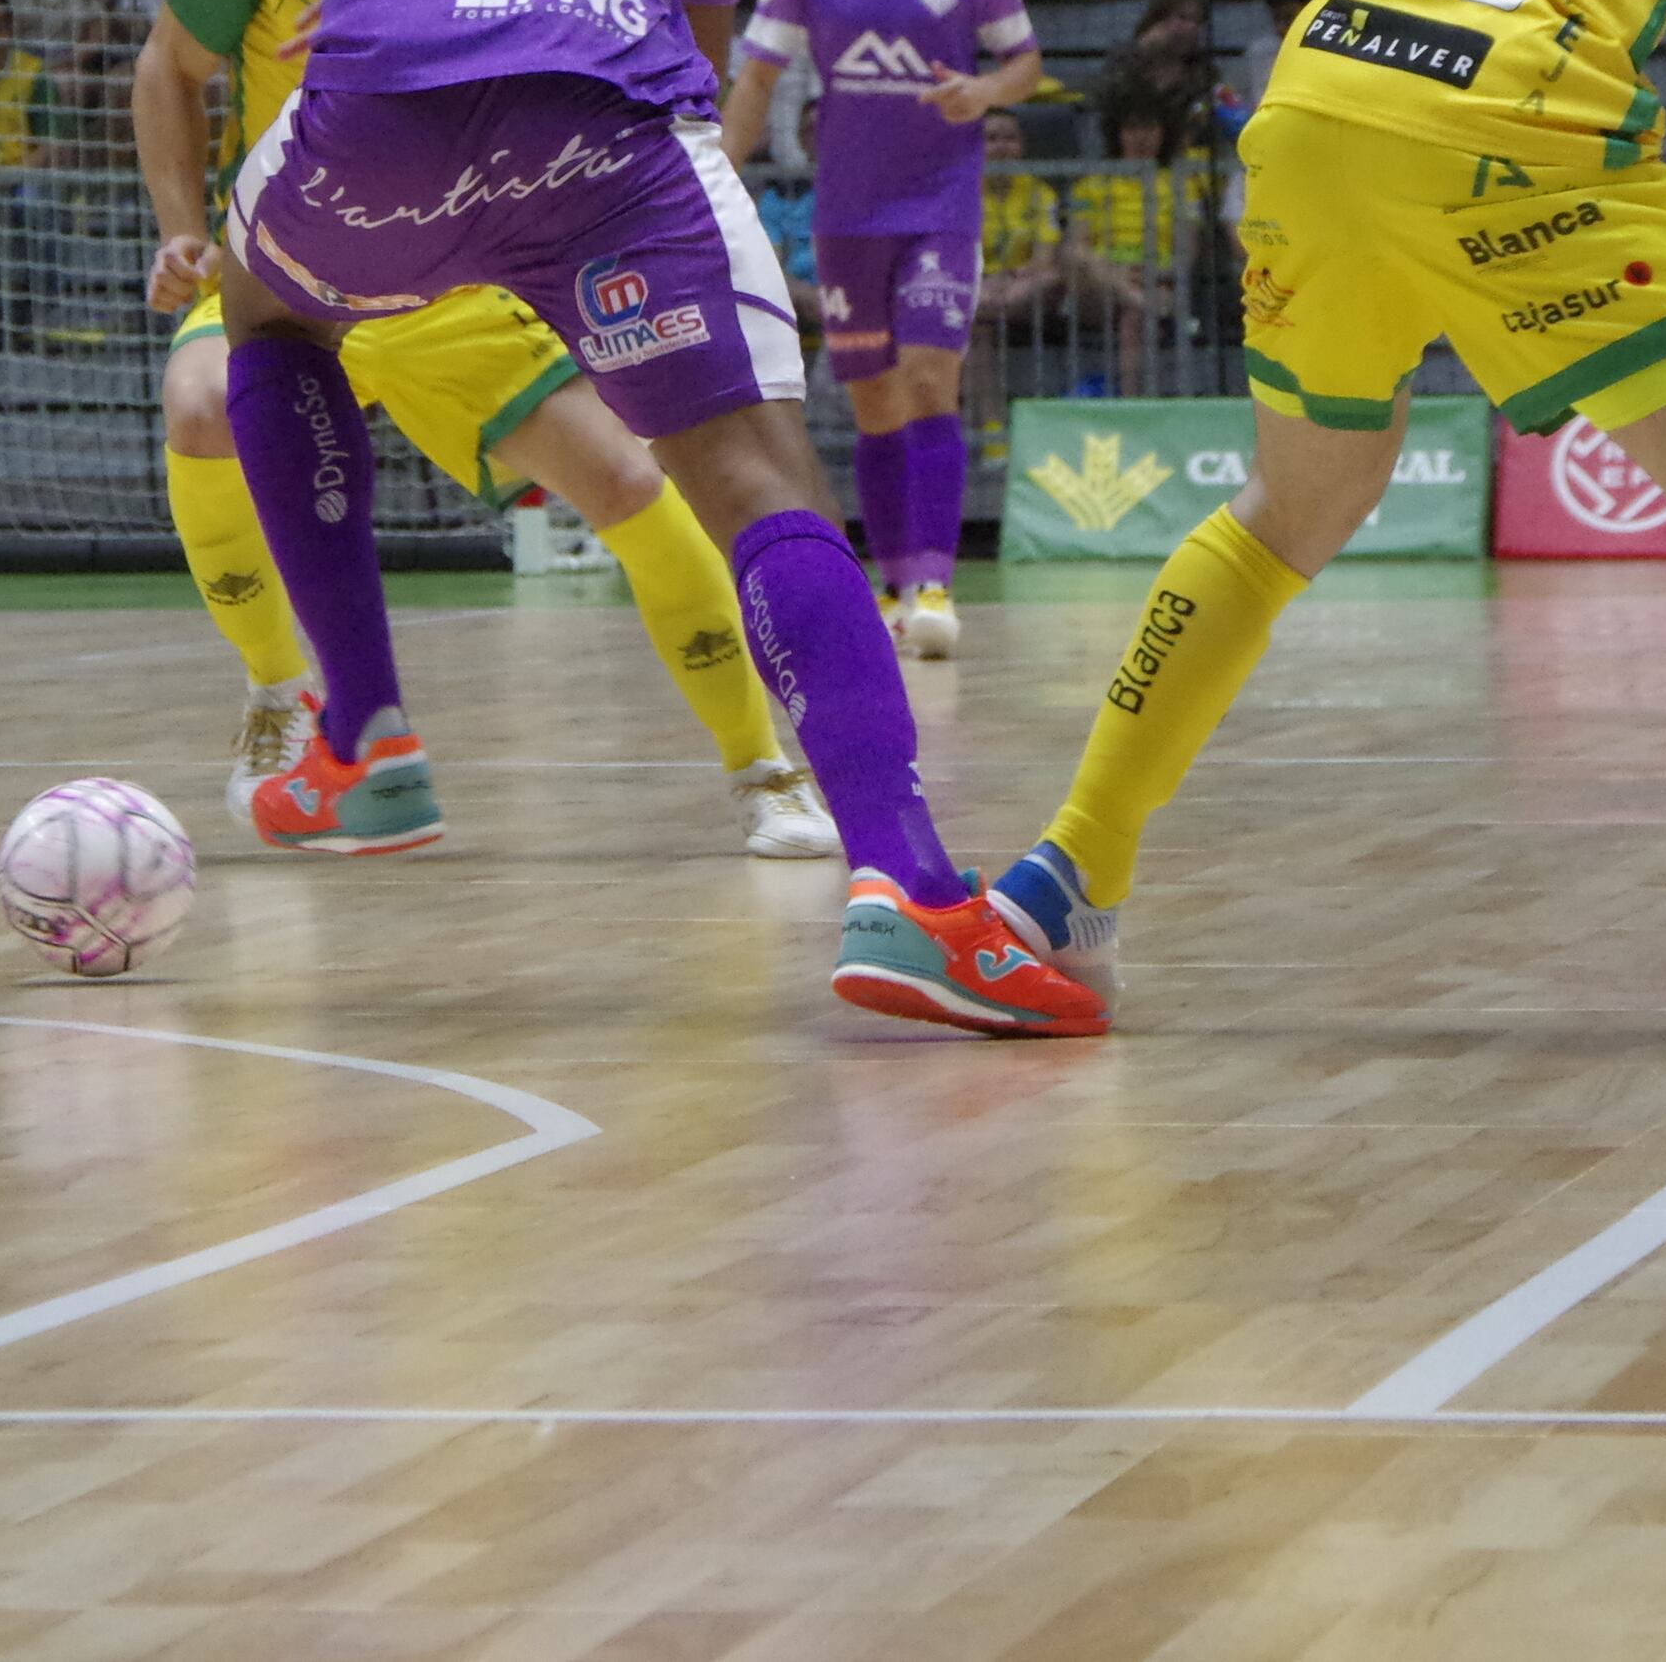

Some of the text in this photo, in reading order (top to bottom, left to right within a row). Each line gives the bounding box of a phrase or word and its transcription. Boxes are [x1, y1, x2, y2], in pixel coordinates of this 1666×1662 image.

[1456, 200, 1607, 267] Blanca
[582, 306, 704, 363] CLIMAES
[1186, 449, 1250, 485] CA
[1107, 589, 1197, 716] Blanca
